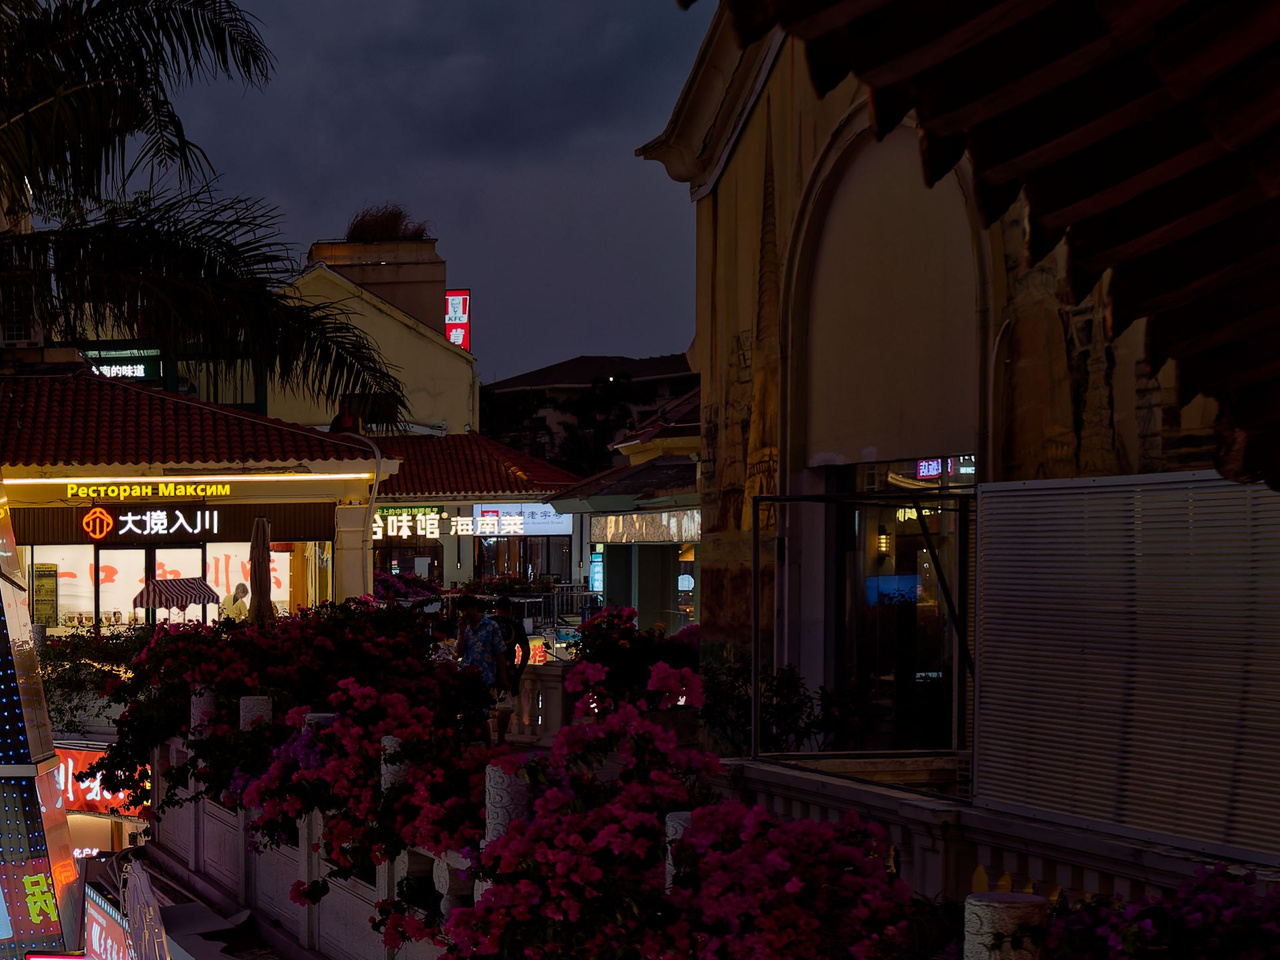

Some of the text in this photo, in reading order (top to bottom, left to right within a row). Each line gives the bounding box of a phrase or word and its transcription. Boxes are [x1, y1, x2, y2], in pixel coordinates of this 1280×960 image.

[67, 482, 231, 500] Ресторан Максим
[449, 515, 524, 537] 海南菜
